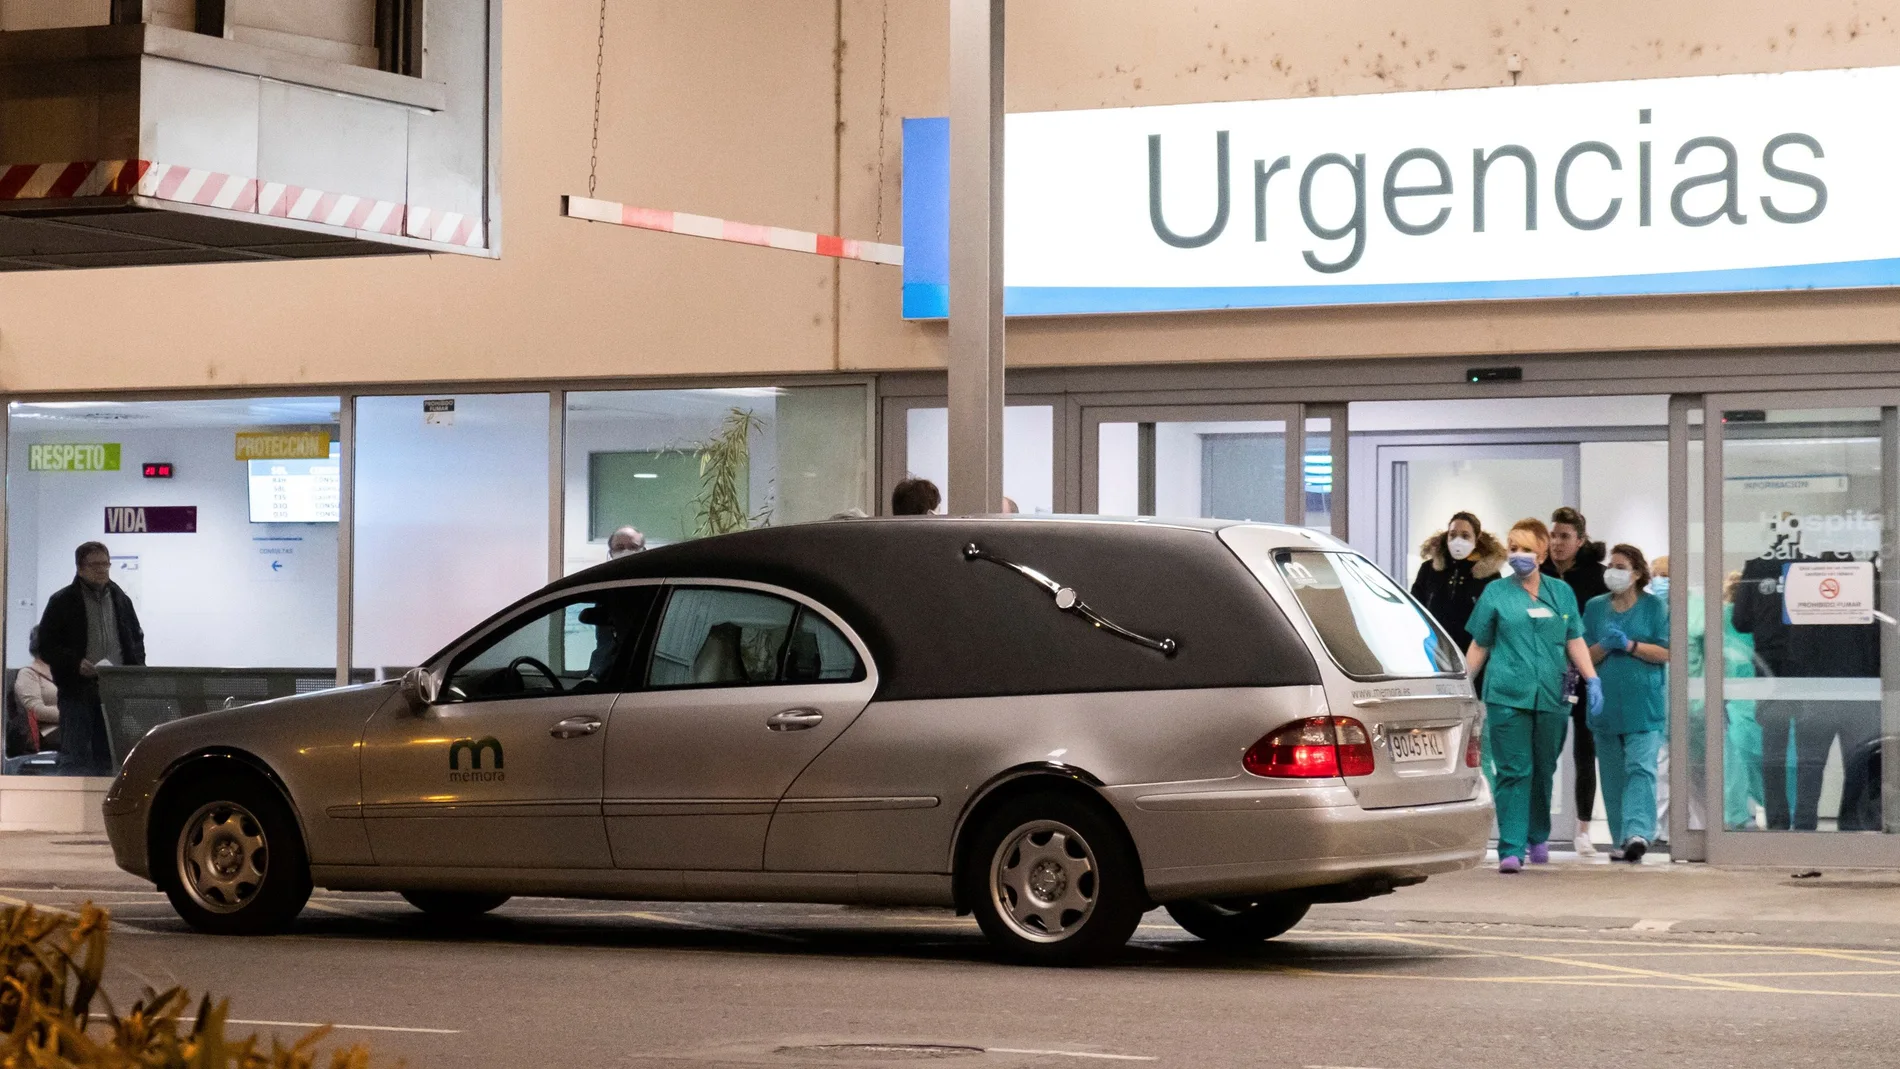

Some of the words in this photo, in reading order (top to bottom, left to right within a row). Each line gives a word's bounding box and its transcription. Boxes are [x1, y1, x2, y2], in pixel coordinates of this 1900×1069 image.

[1147, 108, 1829, 274] Urgencias
[30, 444, 106, 470] RESPETO
[107, 507, 148, 533] VIDA
[1393, 734, 1422, 758] 9045
[1422, 734, 1443, 757] FKL
